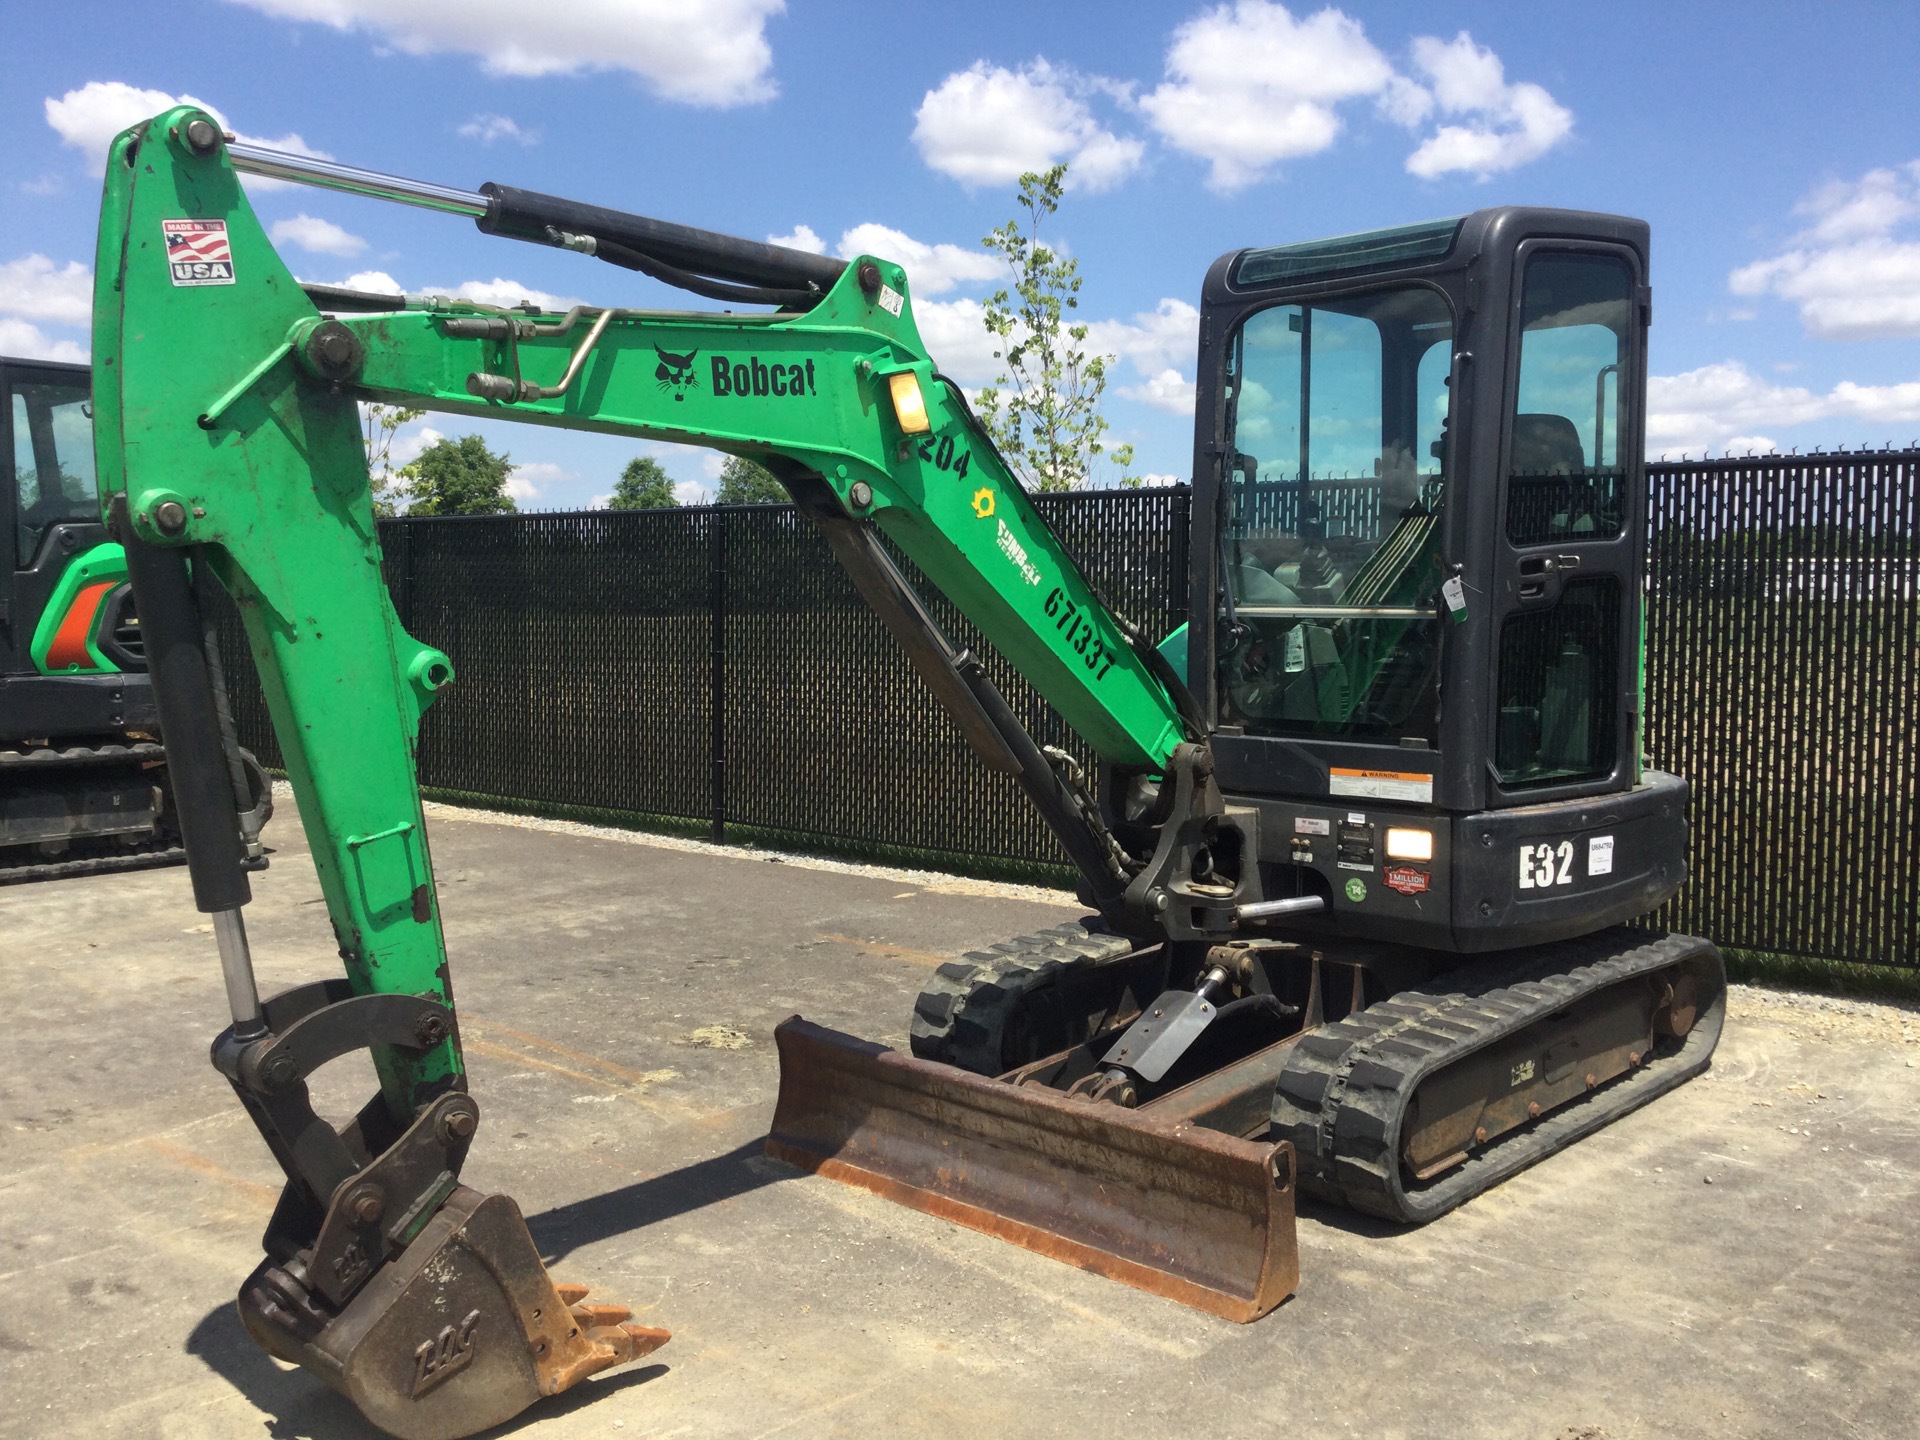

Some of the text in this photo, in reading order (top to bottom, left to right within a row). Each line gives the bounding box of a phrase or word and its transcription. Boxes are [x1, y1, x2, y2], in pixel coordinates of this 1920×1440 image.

[174, 263, 230, 279] USA
[711, 356, 817, 397] Bobcat
[1393, 874, 1425, 883] MILLION
[1519, 841, 1574, 889] E32
